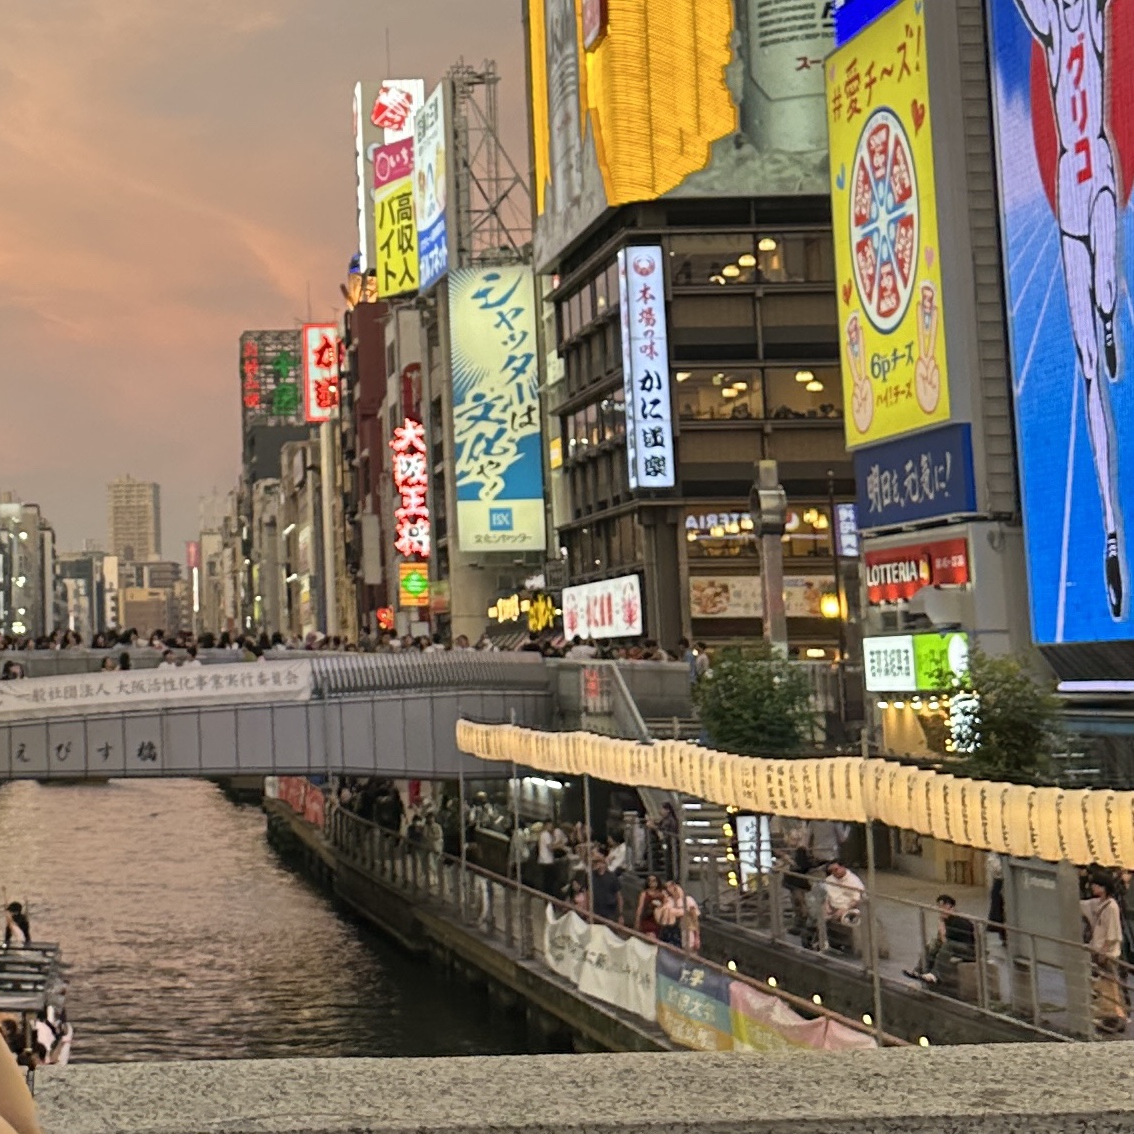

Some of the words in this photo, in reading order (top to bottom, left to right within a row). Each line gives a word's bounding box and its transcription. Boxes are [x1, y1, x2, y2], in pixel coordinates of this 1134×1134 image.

[795, 56, 826, 71] スー
[1066, 33, 1092, 185] グリコ
[379, 197, 397, 292] バイト
[636, 283, 658, 360] 本場の味
[389, 417, 431, 557] 大阪王将
[866, 560, 918, 587] LOTTERIA
